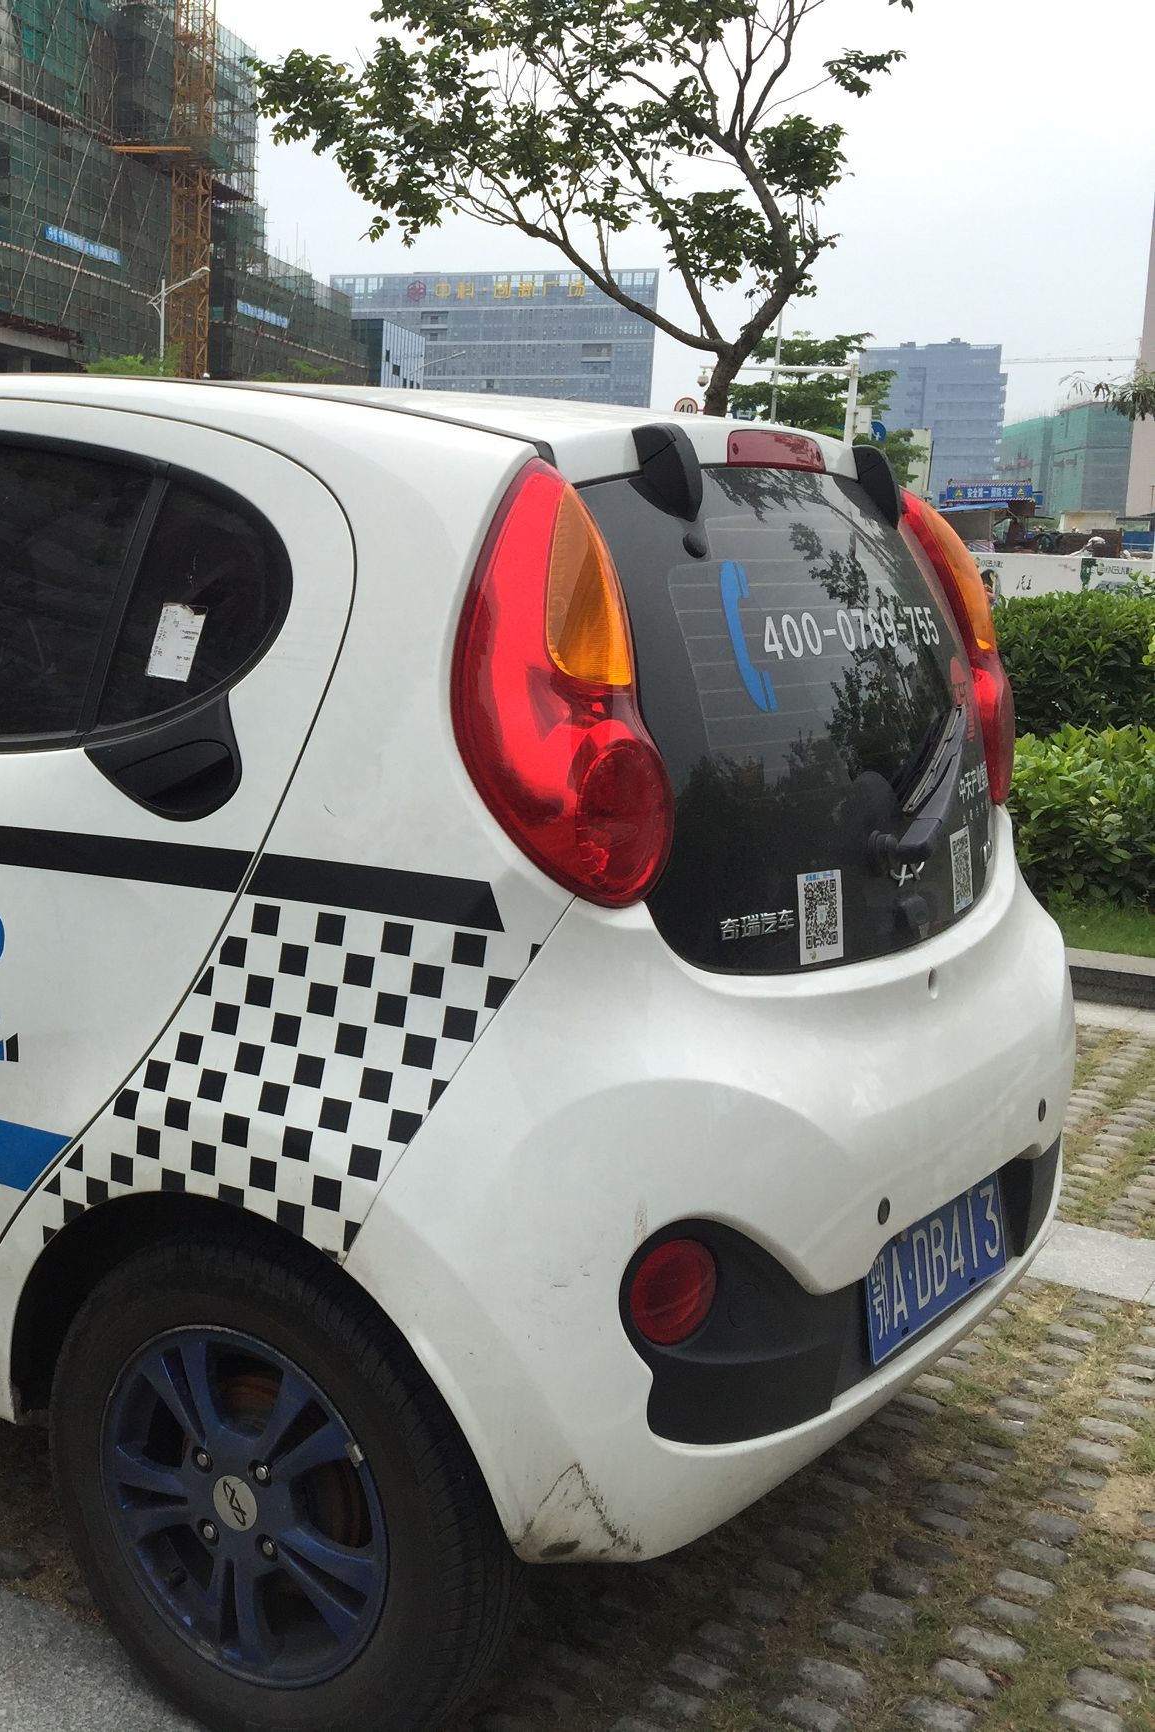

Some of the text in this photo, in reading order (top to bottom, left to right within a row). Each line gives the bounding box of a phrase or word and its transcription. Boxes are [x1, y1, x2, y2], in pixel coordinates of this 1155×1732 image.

[763, 606, 940, 660] 400-0769-755
[719, 908, 796, 942] 奇瑞汽车
